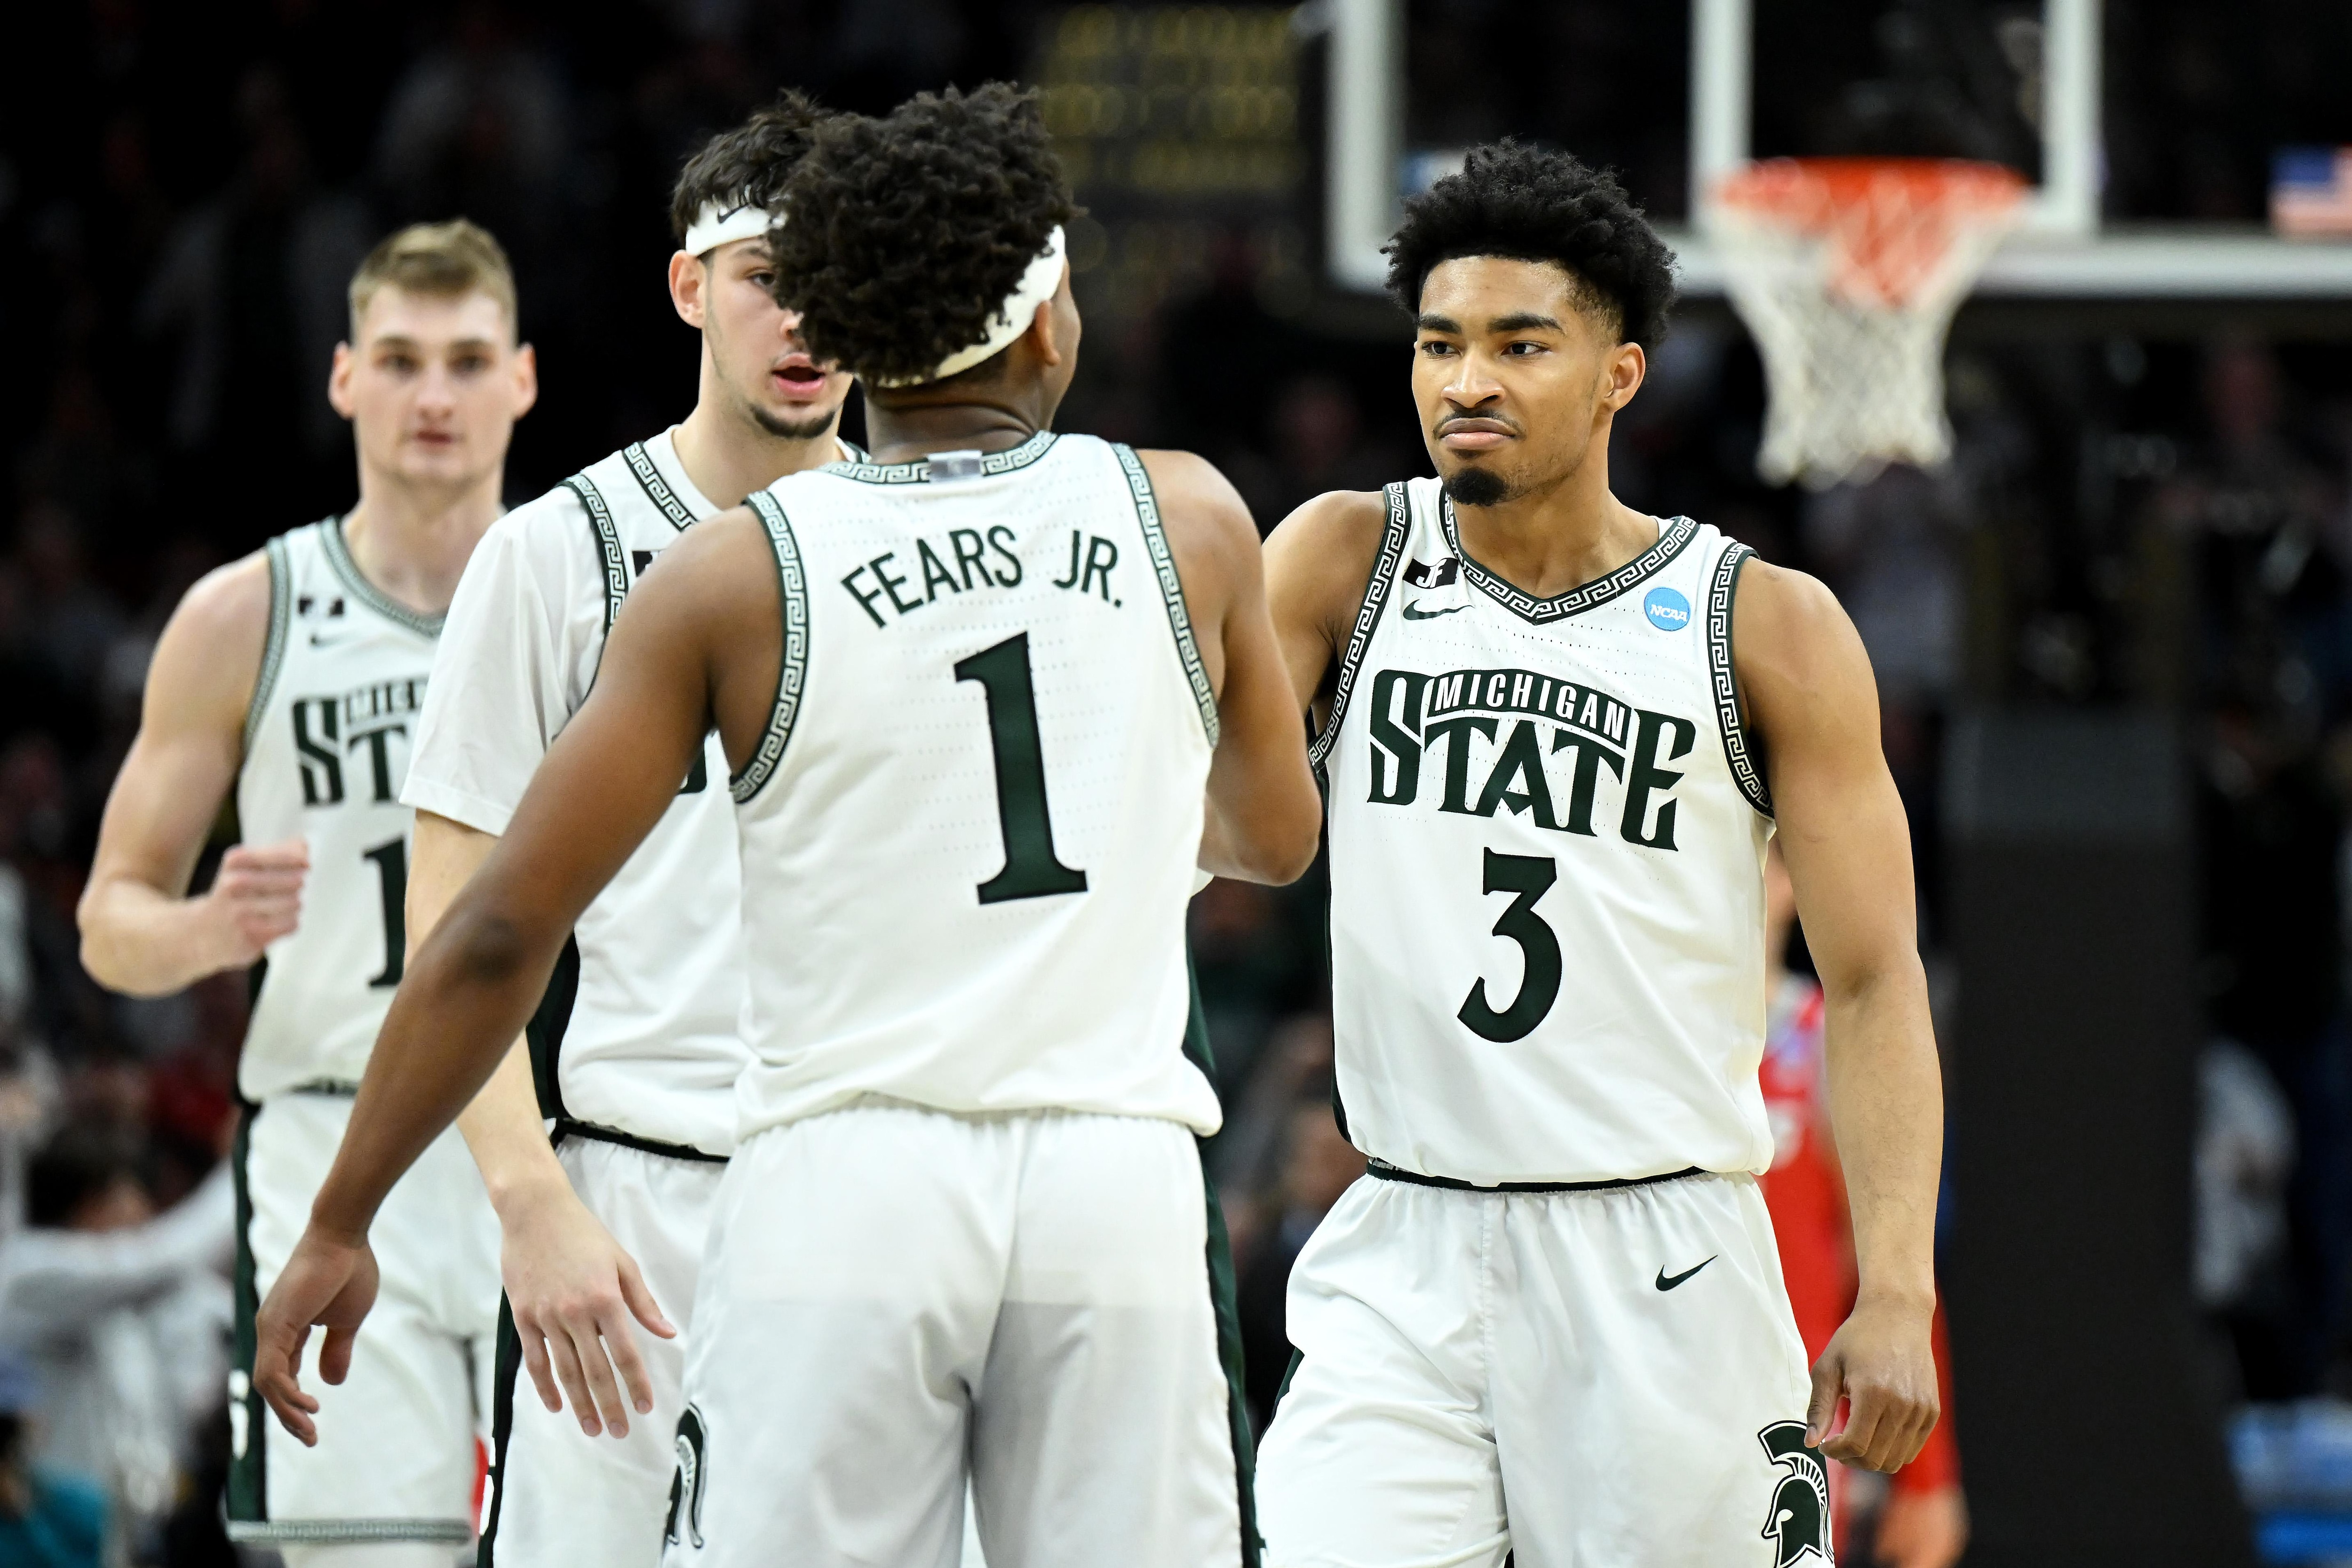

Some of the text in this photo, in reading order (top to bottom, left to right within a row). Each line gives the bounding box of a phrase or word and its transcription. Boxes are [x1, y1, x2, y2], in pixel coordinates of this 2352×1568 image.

[841, 525, 1123, 628] FEARS JR.
[1650, 604, 1688, 622] NCAA
[953, 630, 1089, 906] 1
[1366, 669, 1697, 852] STATE
[1434, 673, 1626, 742] MICHIGAN
[362, 836, 407, 988] 1
[1456, 846, 1563, 1043] 3
